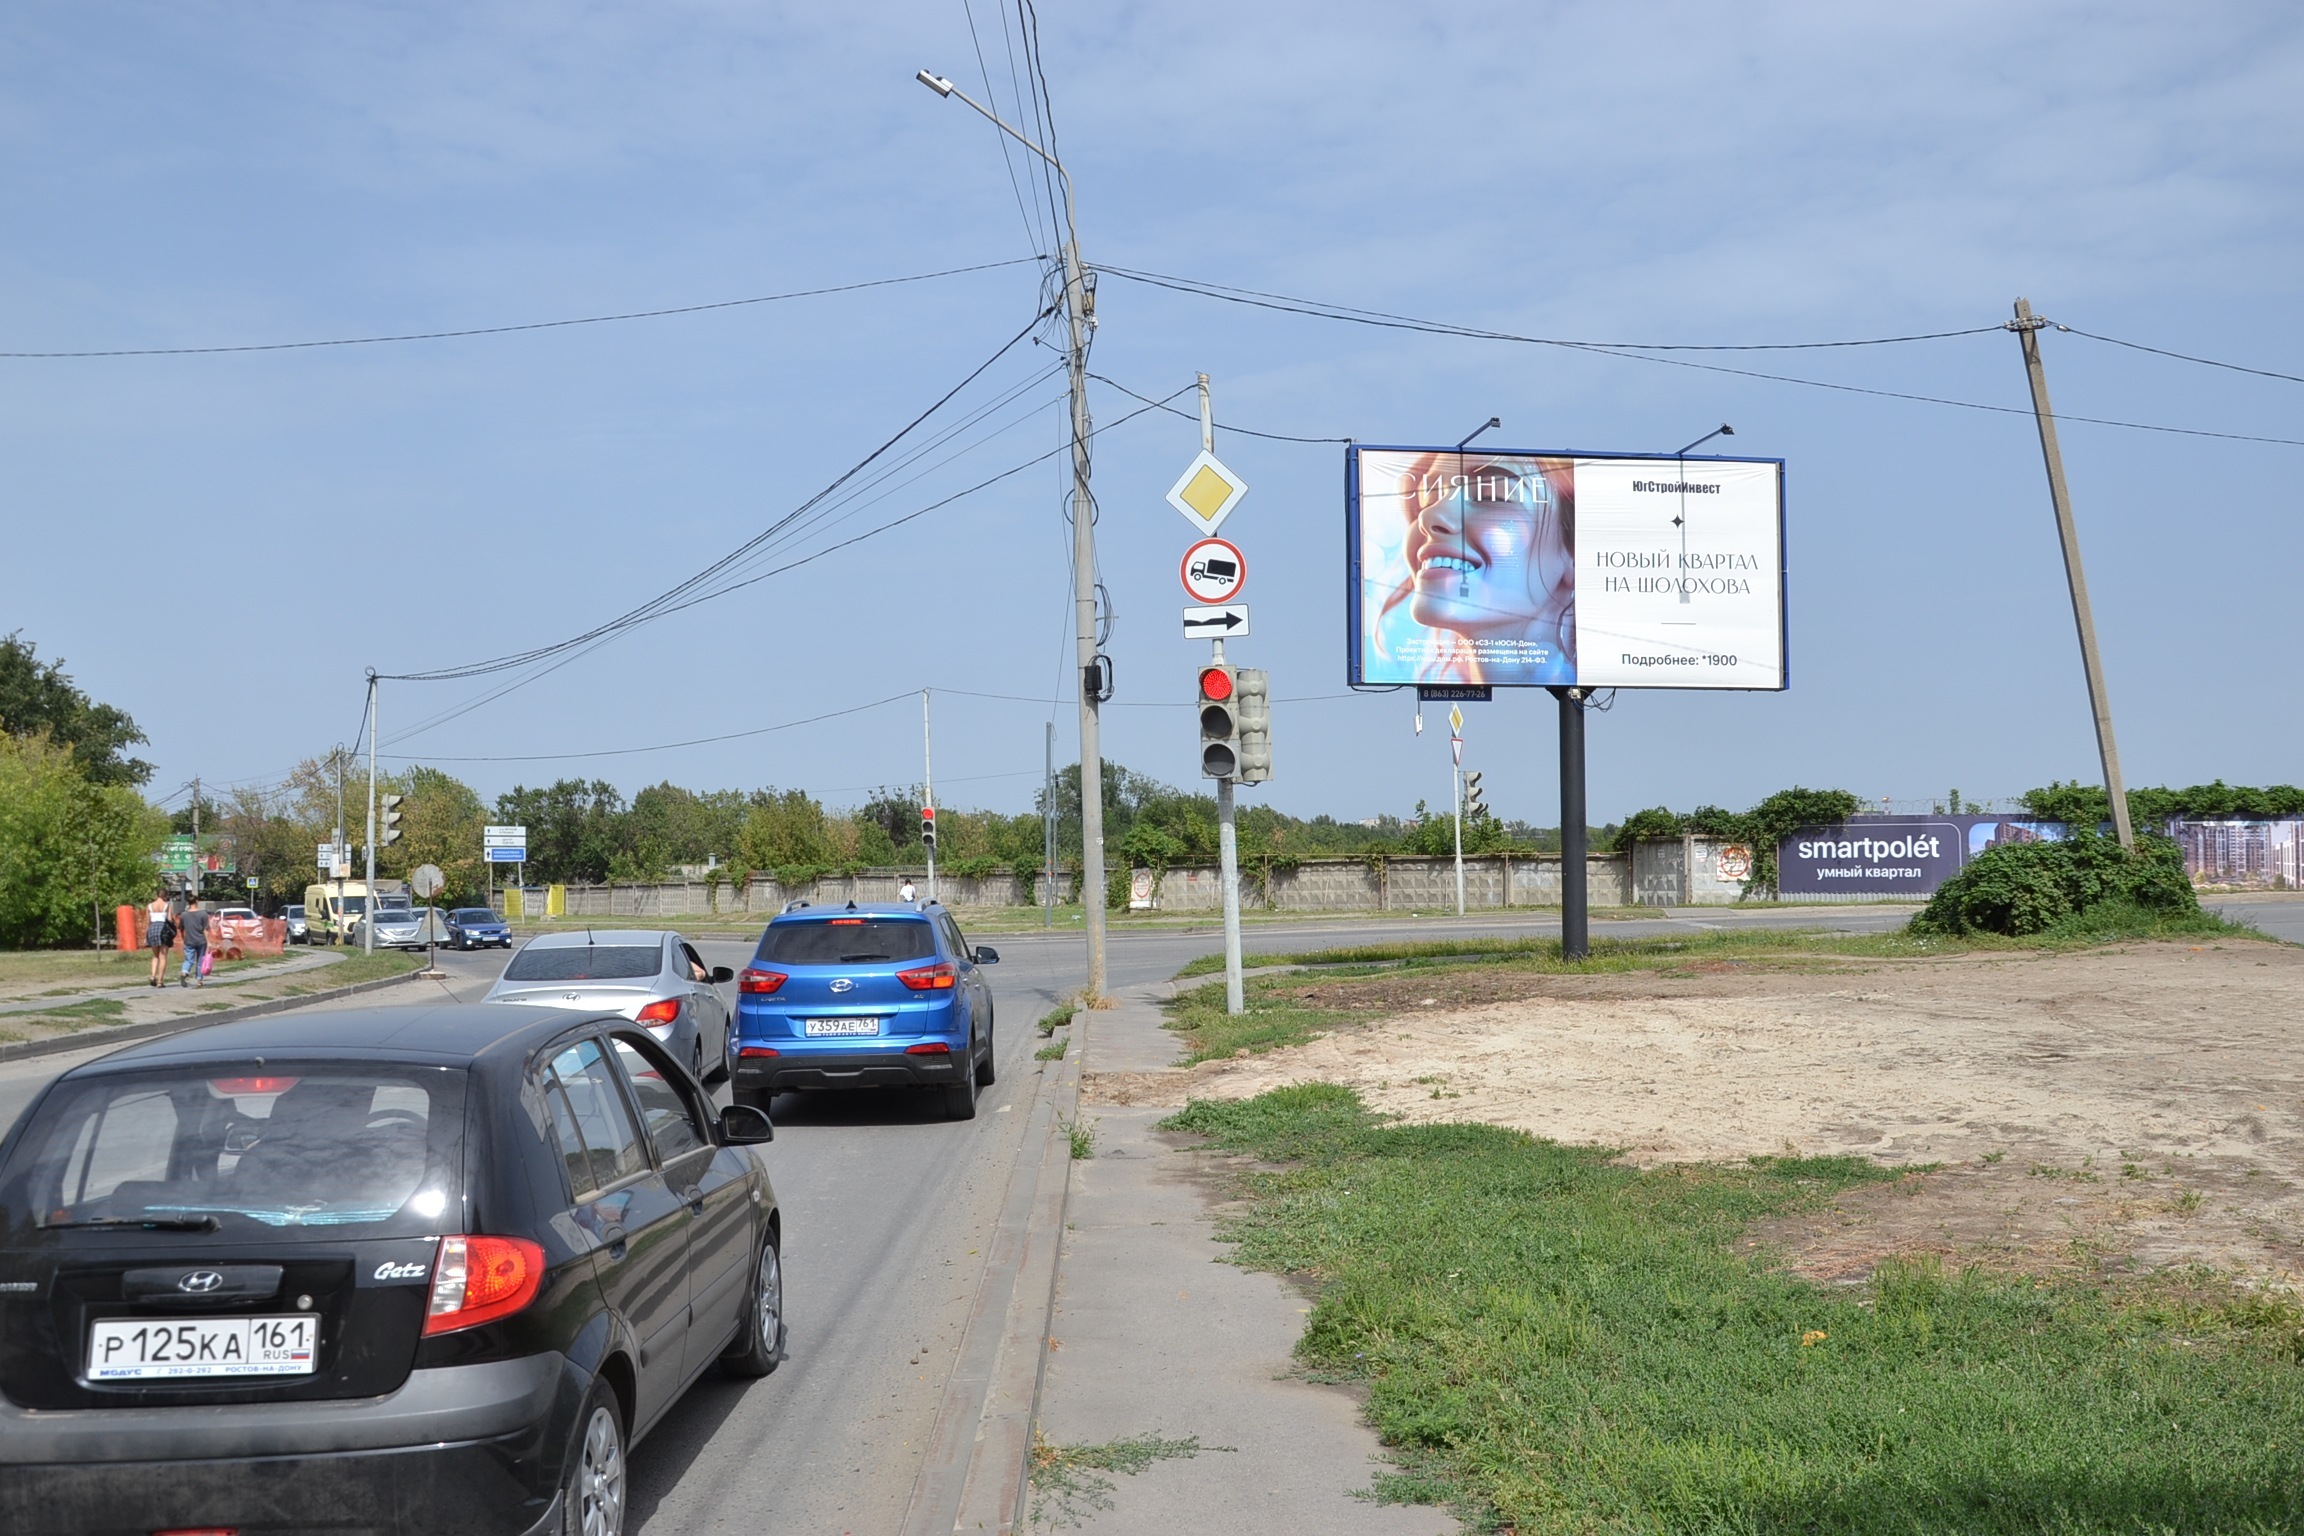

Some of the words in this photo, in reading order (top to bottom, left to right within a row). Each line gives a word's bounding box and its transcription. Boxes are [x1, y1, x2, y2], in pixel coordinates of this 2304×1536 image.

[1394, 472, 1548, 503] СИЯНИЕ
[1633, 480, 1720, 494] ЮгСтройИнвест
[1597, 548, 1670, 568] НОВЫЙ
[1678, 553, 1758, 570] КВАРТАЛ
[1605, 577, 1630, 592] НА
[1638, 577, 1750, 594] ШОЛОХОВА
[1528, 648, 1549, 656] сайте
[1465, 656, 1520, 665] Ростов-на-Дону
[1621, 654, 1699, 667] Подробнее:
[1423, 689, 1429, 698] 8
[1431, 689, 1449, 698] (863)
[1451, 689, 1486, 698] 226-77-26
[1798, 834, 1940, 863] smartpolét
[1816, 865, 1862, 880] умный
[1865, 867, 1921, 881] квартал
[857, 1018, 875, 1028] 761
[374, 1261, 426, 1280] Getz
[104, 1326, 242, 1363] Р125КА
[254, 1321, 304, 1349] 161
[264, 1350, 290, 1360] RUS
[100, 1368, 142, 1376] МОДУС
[225, 1364, 302, 1373] РОСТОВ-НА-ДОНУ
